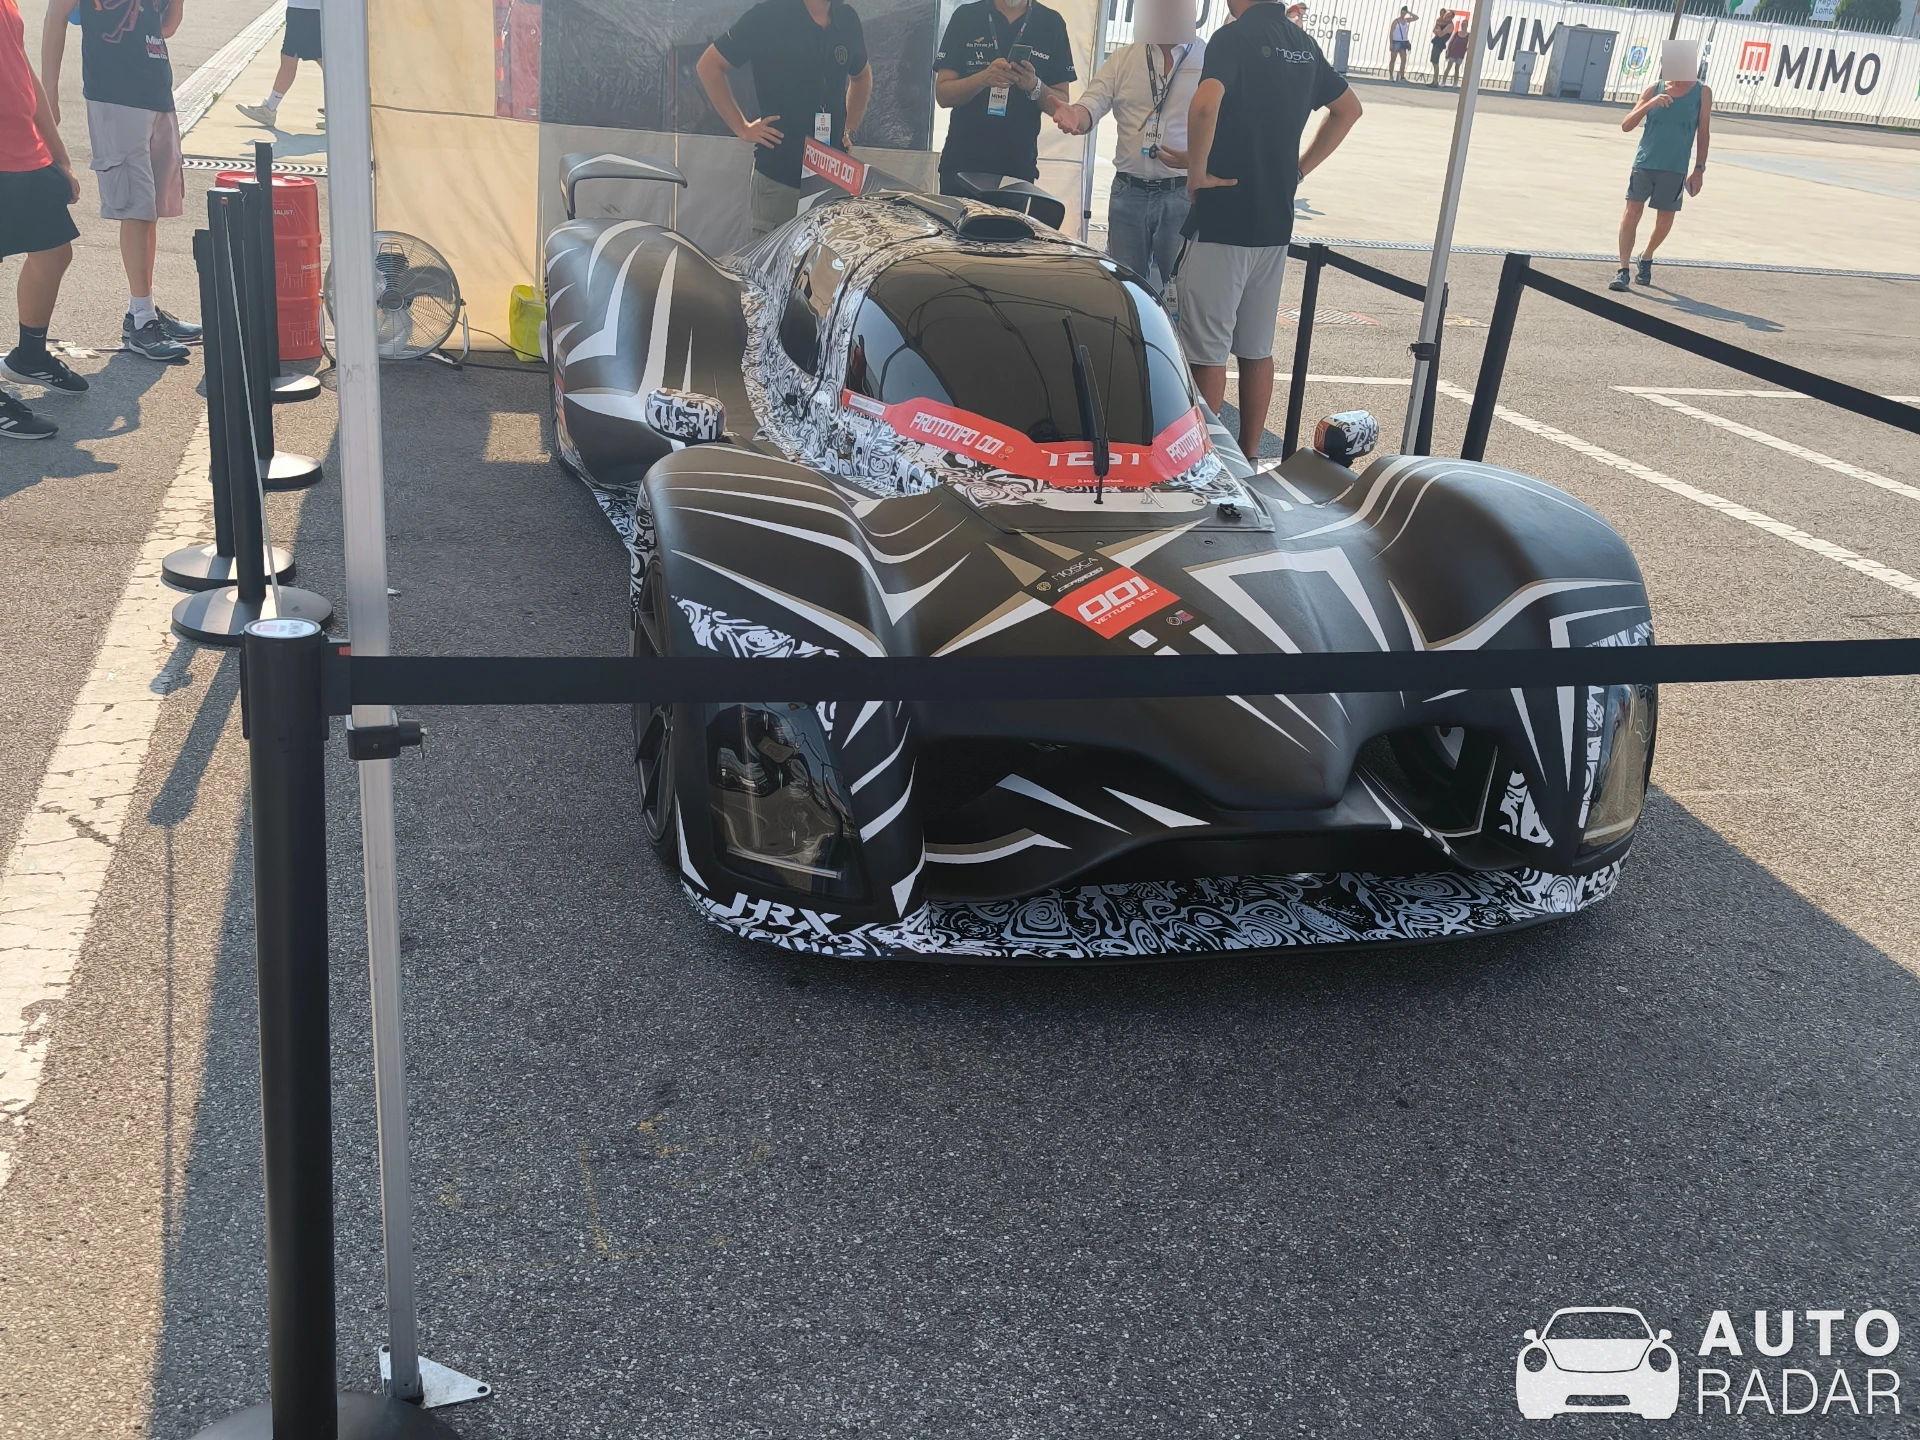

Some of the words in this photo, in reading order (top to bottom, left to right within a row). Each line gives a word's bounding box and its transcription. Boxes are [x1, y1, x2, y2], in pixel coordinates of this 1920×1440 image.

[1301, 12, 1347, 26] egione
[1275, 46, 1315, 61] MOSCA
[1487, 15, 1589, 61] MIM
[1604, 38, 1612, 52] 5
[1773, 44, 1881, 96] MIMO
[804, 143, 841, 177] PROTOTIPO
[909, 411, 981, 446] PROTOTIPO
[974, 434, 1005, 455] 001
[1051, 557, 1099, 581] MOSCA
[1077, 575, 1150, 622] 001
[1094, 600, 1136, 625] VETTURA
[1136, 588, 1159, 602] TEST
